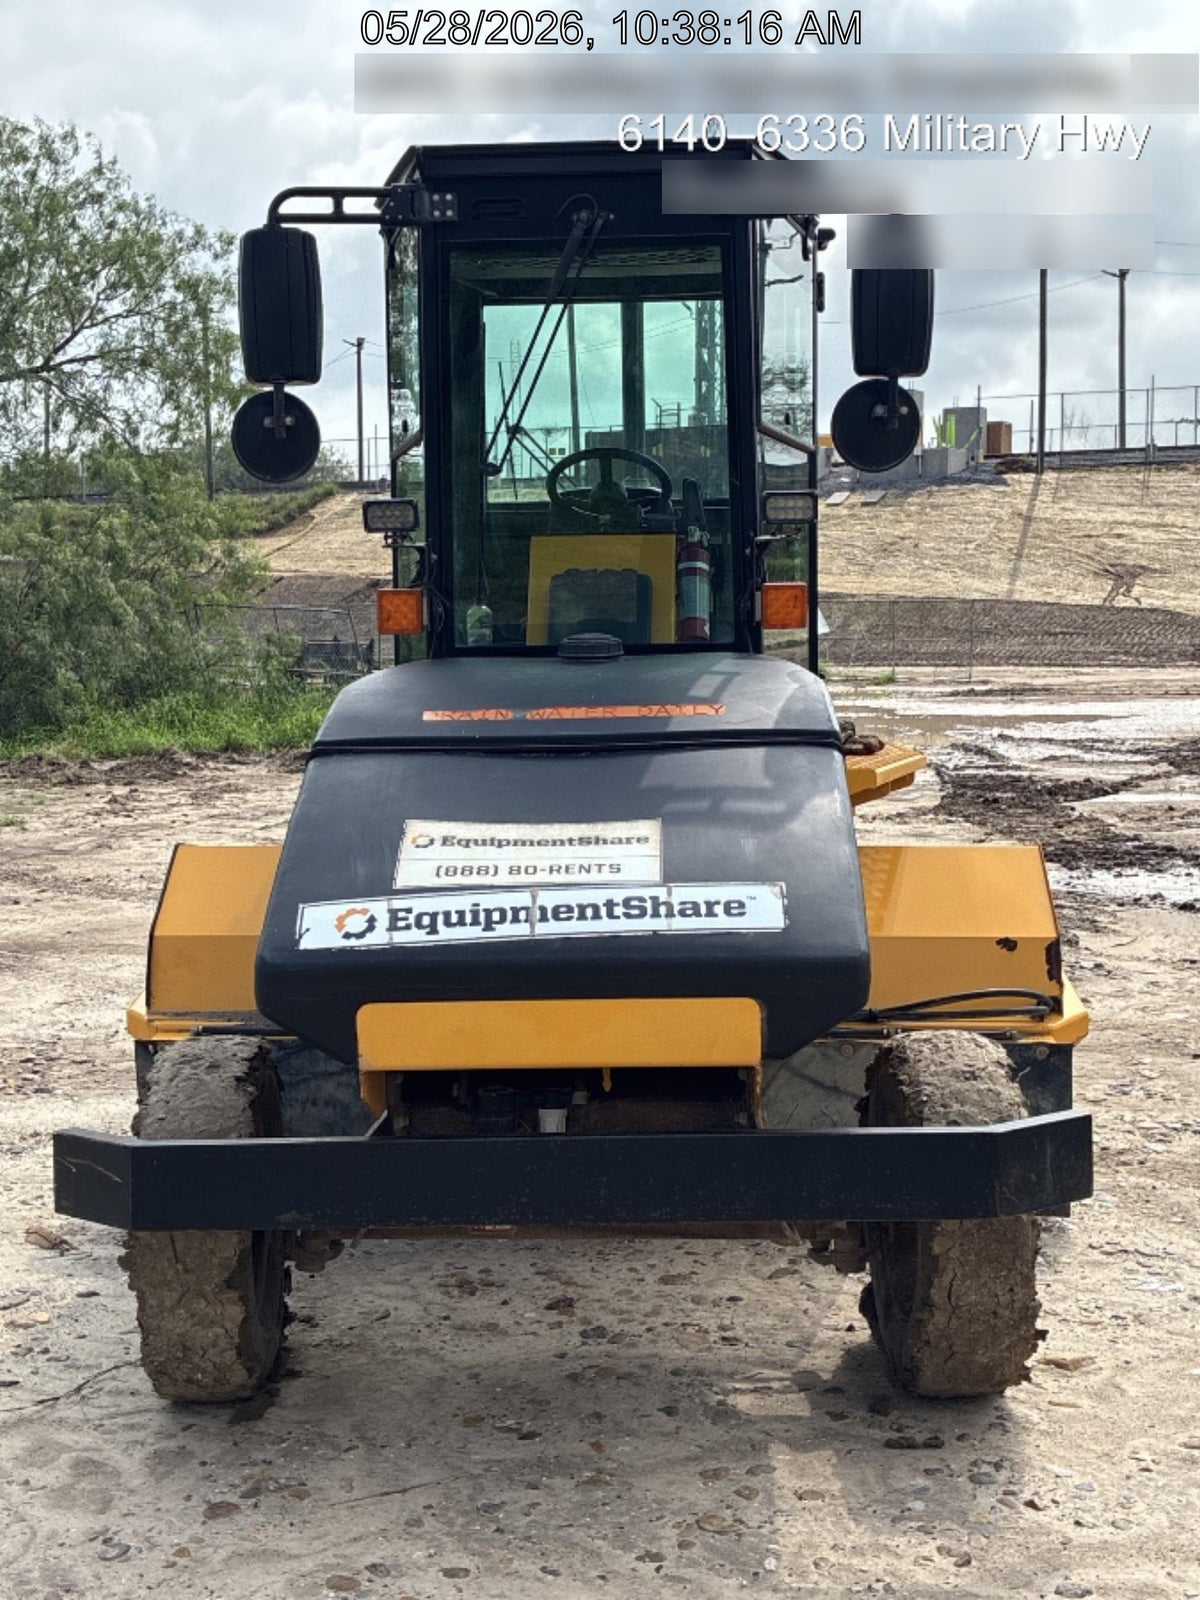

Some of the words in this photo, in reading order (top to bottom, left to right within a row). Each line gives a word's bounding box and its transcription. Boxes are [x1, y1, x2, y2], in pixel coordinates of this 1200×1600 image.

[440, 834, 650, 849] EquipmentShare
[435, 864, 499, 878] (888)
[508, 863, 622, 876] 80-RENTS
[385, 895, 748, 936] EquipmentShare
